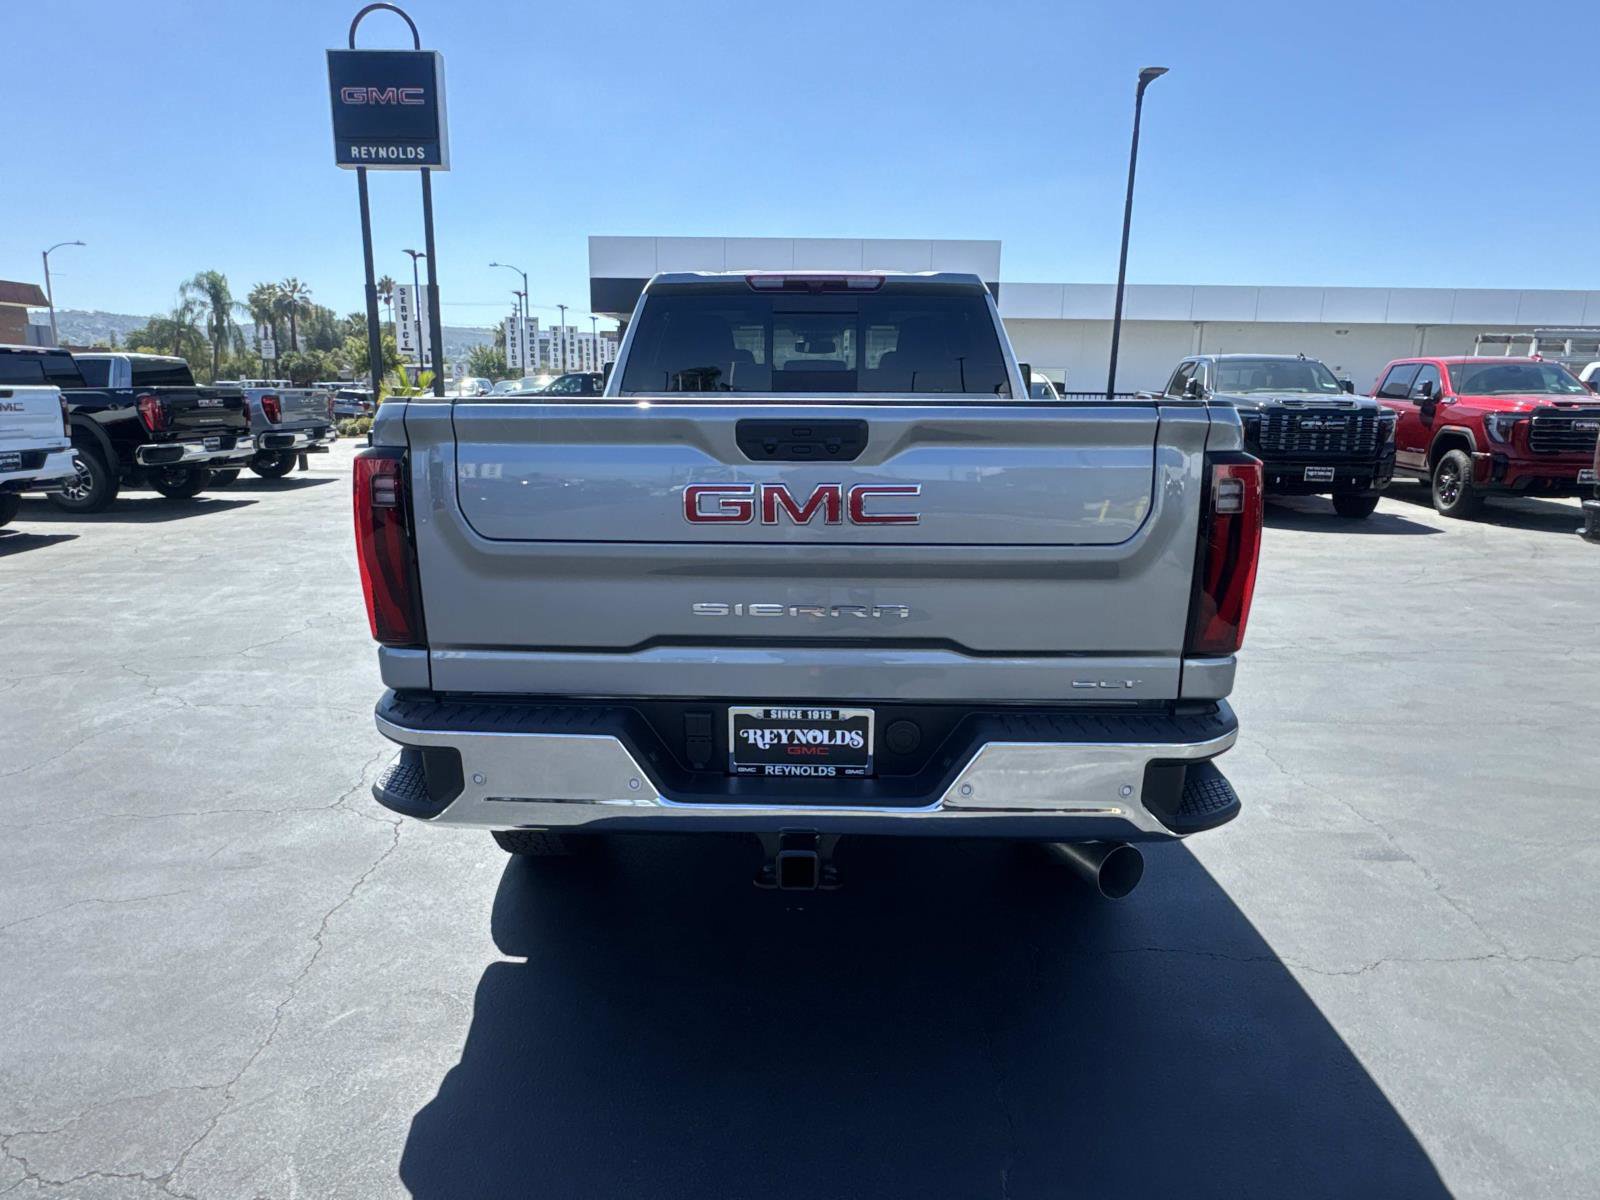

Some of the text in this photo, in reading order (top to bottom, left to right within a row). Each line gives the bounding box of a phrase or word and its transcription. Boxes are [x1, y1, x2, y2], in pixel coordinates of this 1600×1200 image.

[341, 87, 424, 105] GMC
[351, 146, 425, 159] REYNOLDS
[399, 288, 410, 347] SERVICE
[0, 402, 24, 411] MC
[683, 483, 921, 526] GMC
[692, 603, 910, 618] SIERRA
[770, 710, 832, 719] SINCE 1915
[739, 728, 864, 749] REYNOLDS
[787, 747, 830, 755] GMC
[765, 766, 836, 776] REYNOLDS
